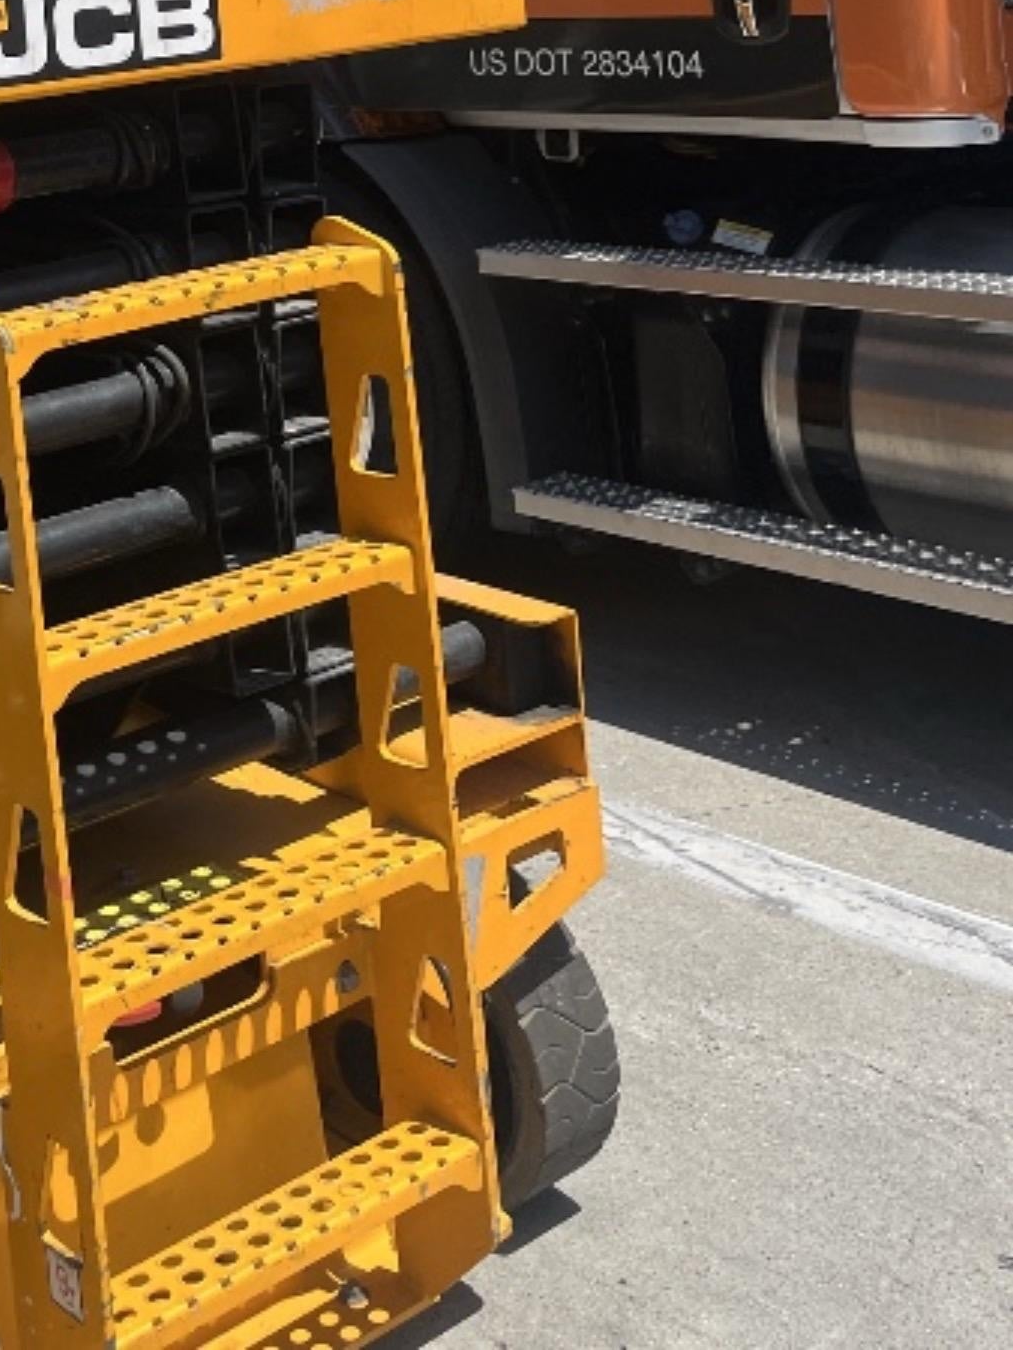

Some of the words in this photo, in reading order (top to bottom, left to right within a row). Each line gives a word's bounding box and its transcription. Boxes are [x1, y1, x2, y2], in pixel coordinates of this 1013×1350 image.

[469, 49, 508, 78] US
[514, 49, 572, 78] DOT
[582, 49, 705, 79] 2834104
